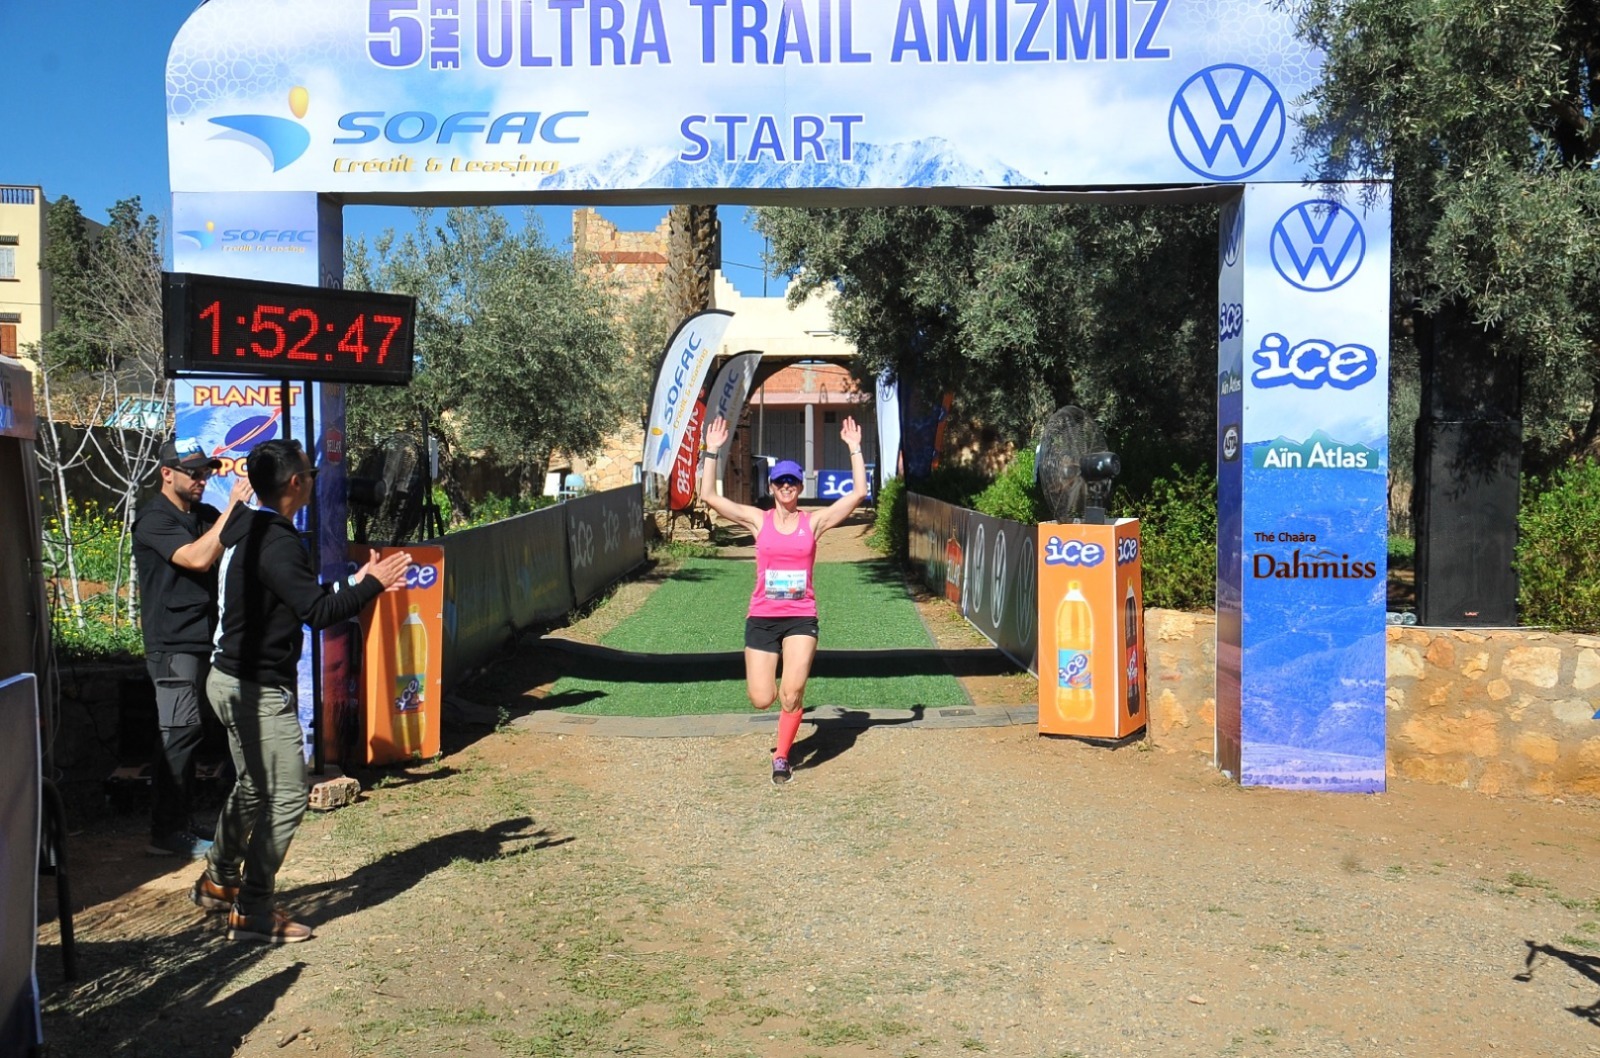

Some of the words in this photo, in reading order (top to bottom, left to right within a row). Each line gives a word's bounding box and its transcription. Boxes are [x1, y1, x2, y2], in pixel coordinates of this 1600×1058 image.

[368, 0, 423, 67] 5
[476, 0, 671, 68] ULTRA
[690, 0, 871, 64] TRAIL
[891, 0, 1171, 62] AMIZMIZ
[333, 110, 589, 145] SOFAC
[680, 114, 864, 163] START
[333, 153, 416, 173] Crédit
[424, 157, 443, 173] &
[450, 154, 561, 175] Leasing
[222, 229, 316, 243] SOFAC
[199, 300, 402, 364] 1:52:47
[1220, 304, 1242, 340] ice
[1254, 334, 1376, 389] ice
[664, 332, 702, 425] SOFAC
[193, 386, 302, 407] PLANET
[1263, 447, 1302, 468] Aïn
[1307, 442, 1369, 468] Atlas
[1046, 537, 1104, 565] ice
[1117, 537, 1138, 564] ice
[1254, 532, 1275, 542] Thé
[404, 564, 434, 586] ce
[1253, 548, 1377, 579] Dahmiss
[1058, 655, 1087, 682] ice
